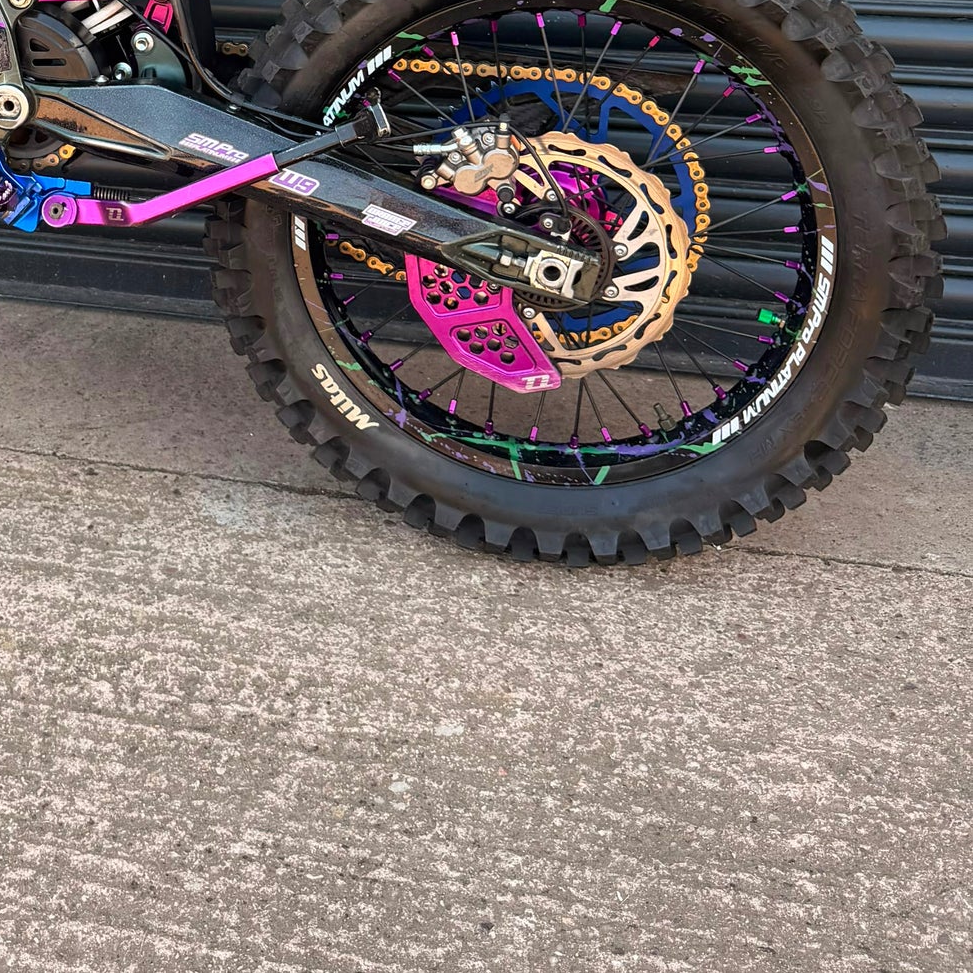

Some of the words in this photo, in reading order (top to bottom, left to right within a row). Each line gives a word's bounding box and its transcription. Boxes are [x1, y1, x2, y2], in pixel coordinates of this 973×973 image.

[322, 69, 365, 127] ATINUM
[310, 363, 380, 431] Mitas
[741, 341, 807, 425] PLATINUM
